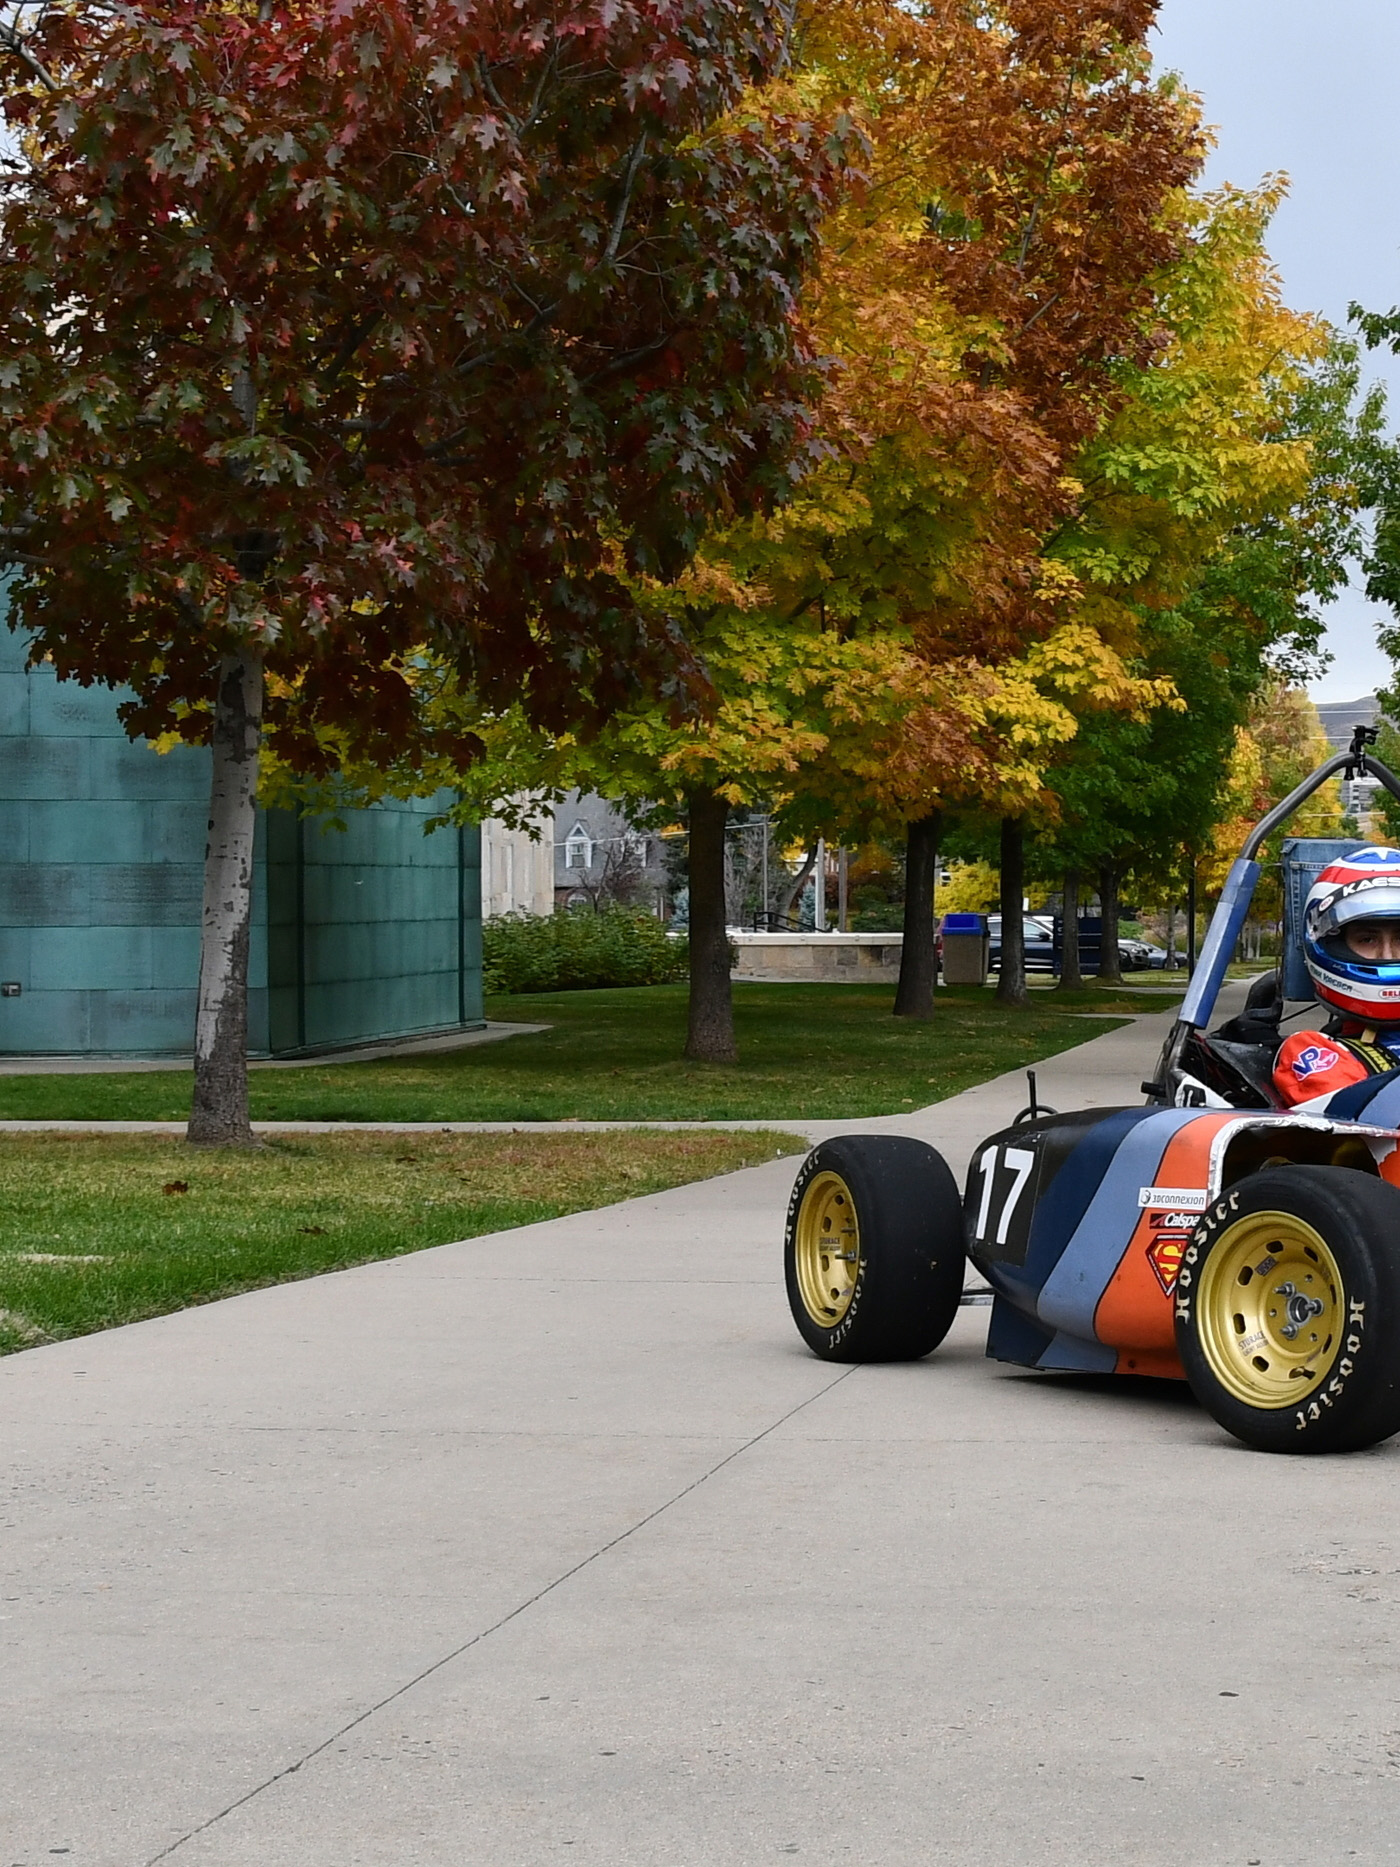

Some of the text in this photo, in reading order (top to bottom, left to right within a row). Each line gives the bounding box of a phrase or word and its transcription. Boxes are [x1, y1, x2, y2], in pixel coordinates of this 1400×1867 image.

[1293, 1047, 1319, 1075] VP
[976, 1145, 1035, 1244] 17
[1165, 1213, 1200, 1229] Calspa
